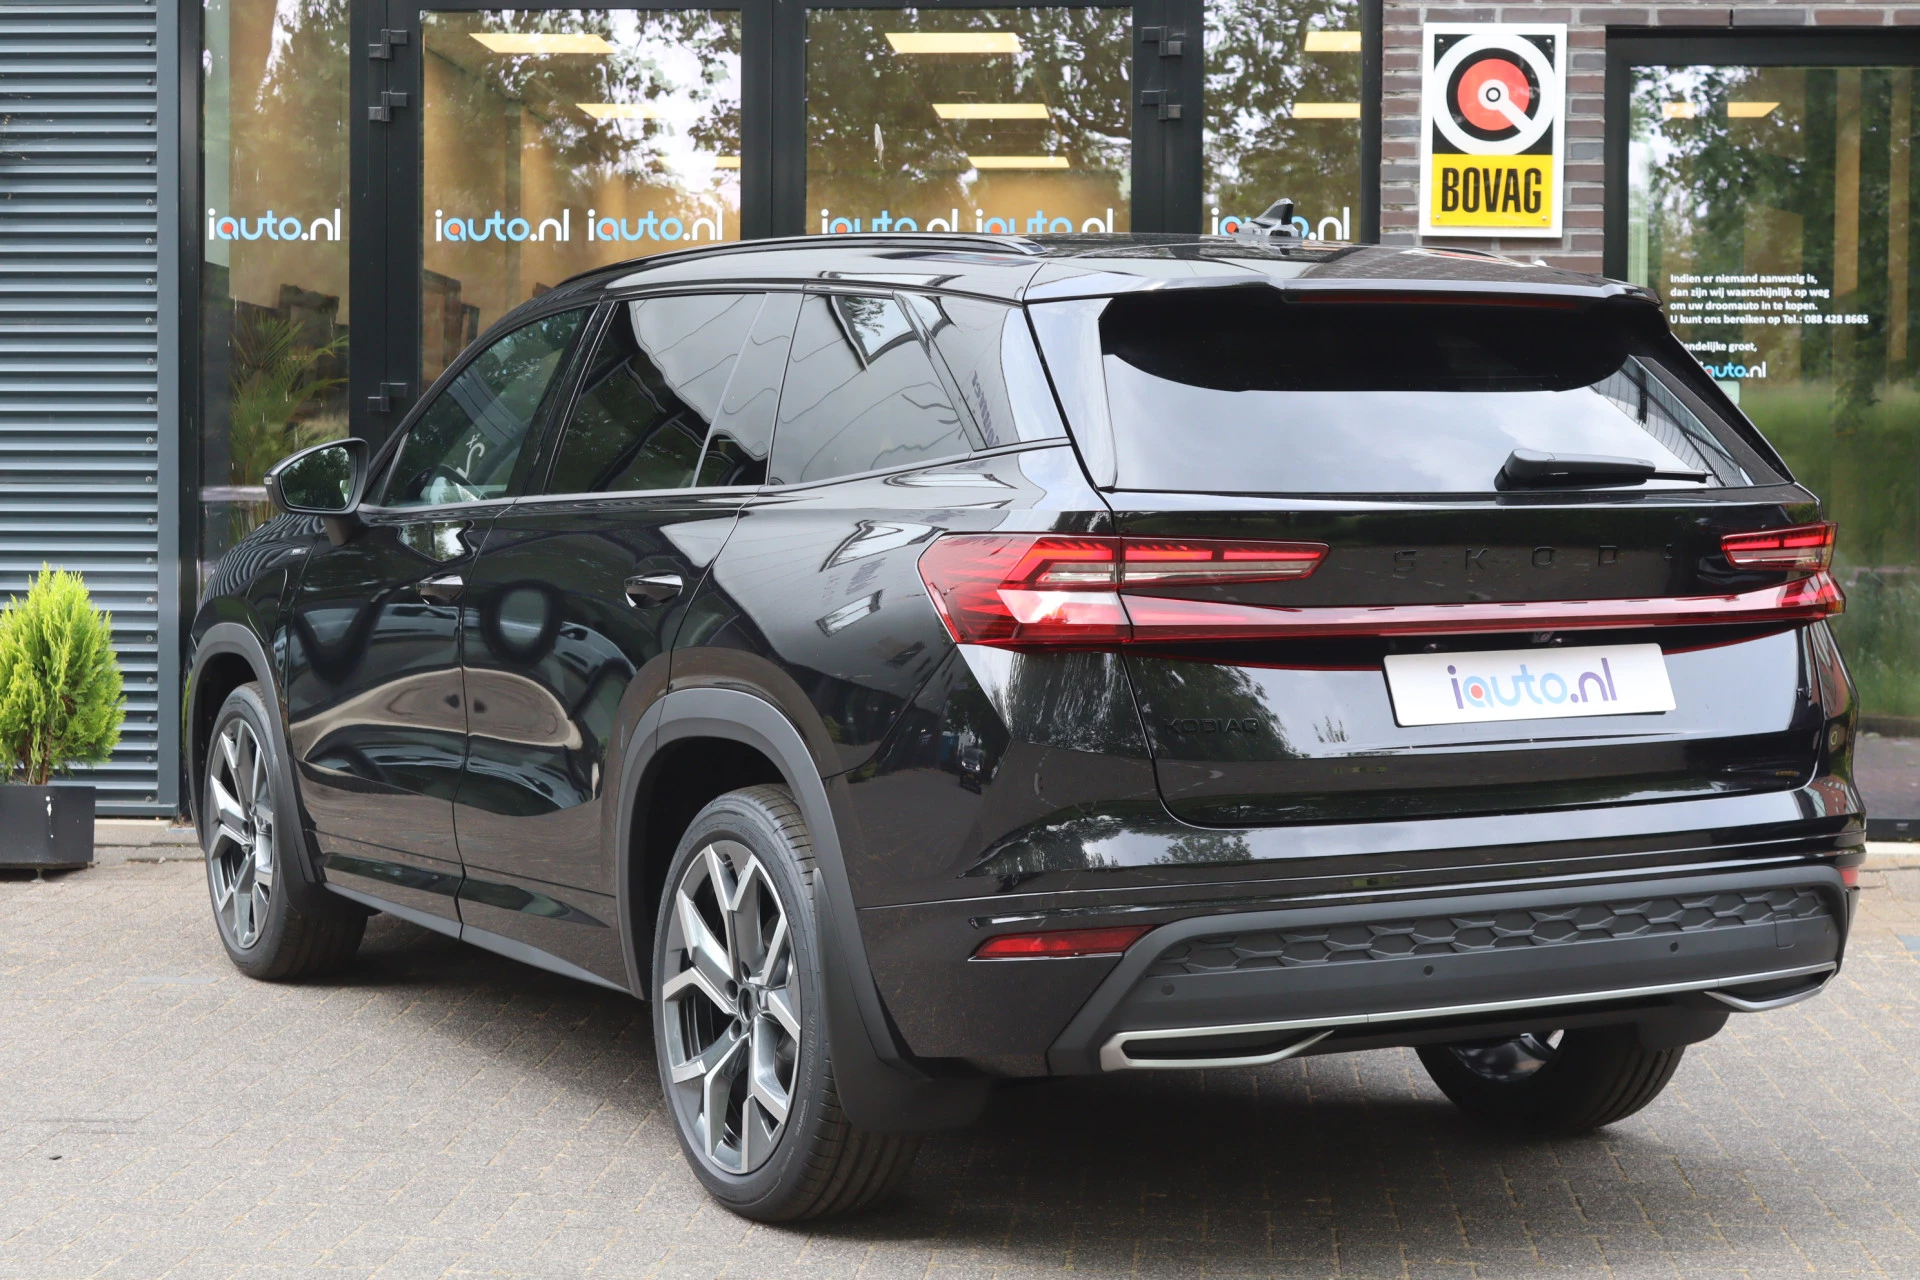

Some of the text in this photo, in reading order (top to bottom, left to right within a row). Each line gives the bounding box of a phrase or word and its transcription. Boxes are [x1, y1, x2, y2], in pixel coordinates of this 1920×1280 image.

[1441, 167, 1542, 213] BOVAG
[208, 208, 341, 241] iauto.nl
[435, 208, 570, 242] iauto.nl
[588, 208, 724, 241] iauto.nl
[821, 208, 958, 234] iautonl
[975, 208, 1113, 233] iautonl
[1670, 273, 1818, 285] Indien er niemand aanwezig is,
[1670, 287, 1830, 299] dan zijn wij waarschijnlijk op weg
[1670, 301, 1818, 312] om uw droomauto in te kopen.
[1670, 314, 1869, 325] U kunt ons bereiken op Tel.: 088 428 8665
[1681, 341, 1758, 353] endelijke groet,
[1447, 657, 1618, 709] iauto.nl
[1163, 718, 1260, 734] KODIAQ
